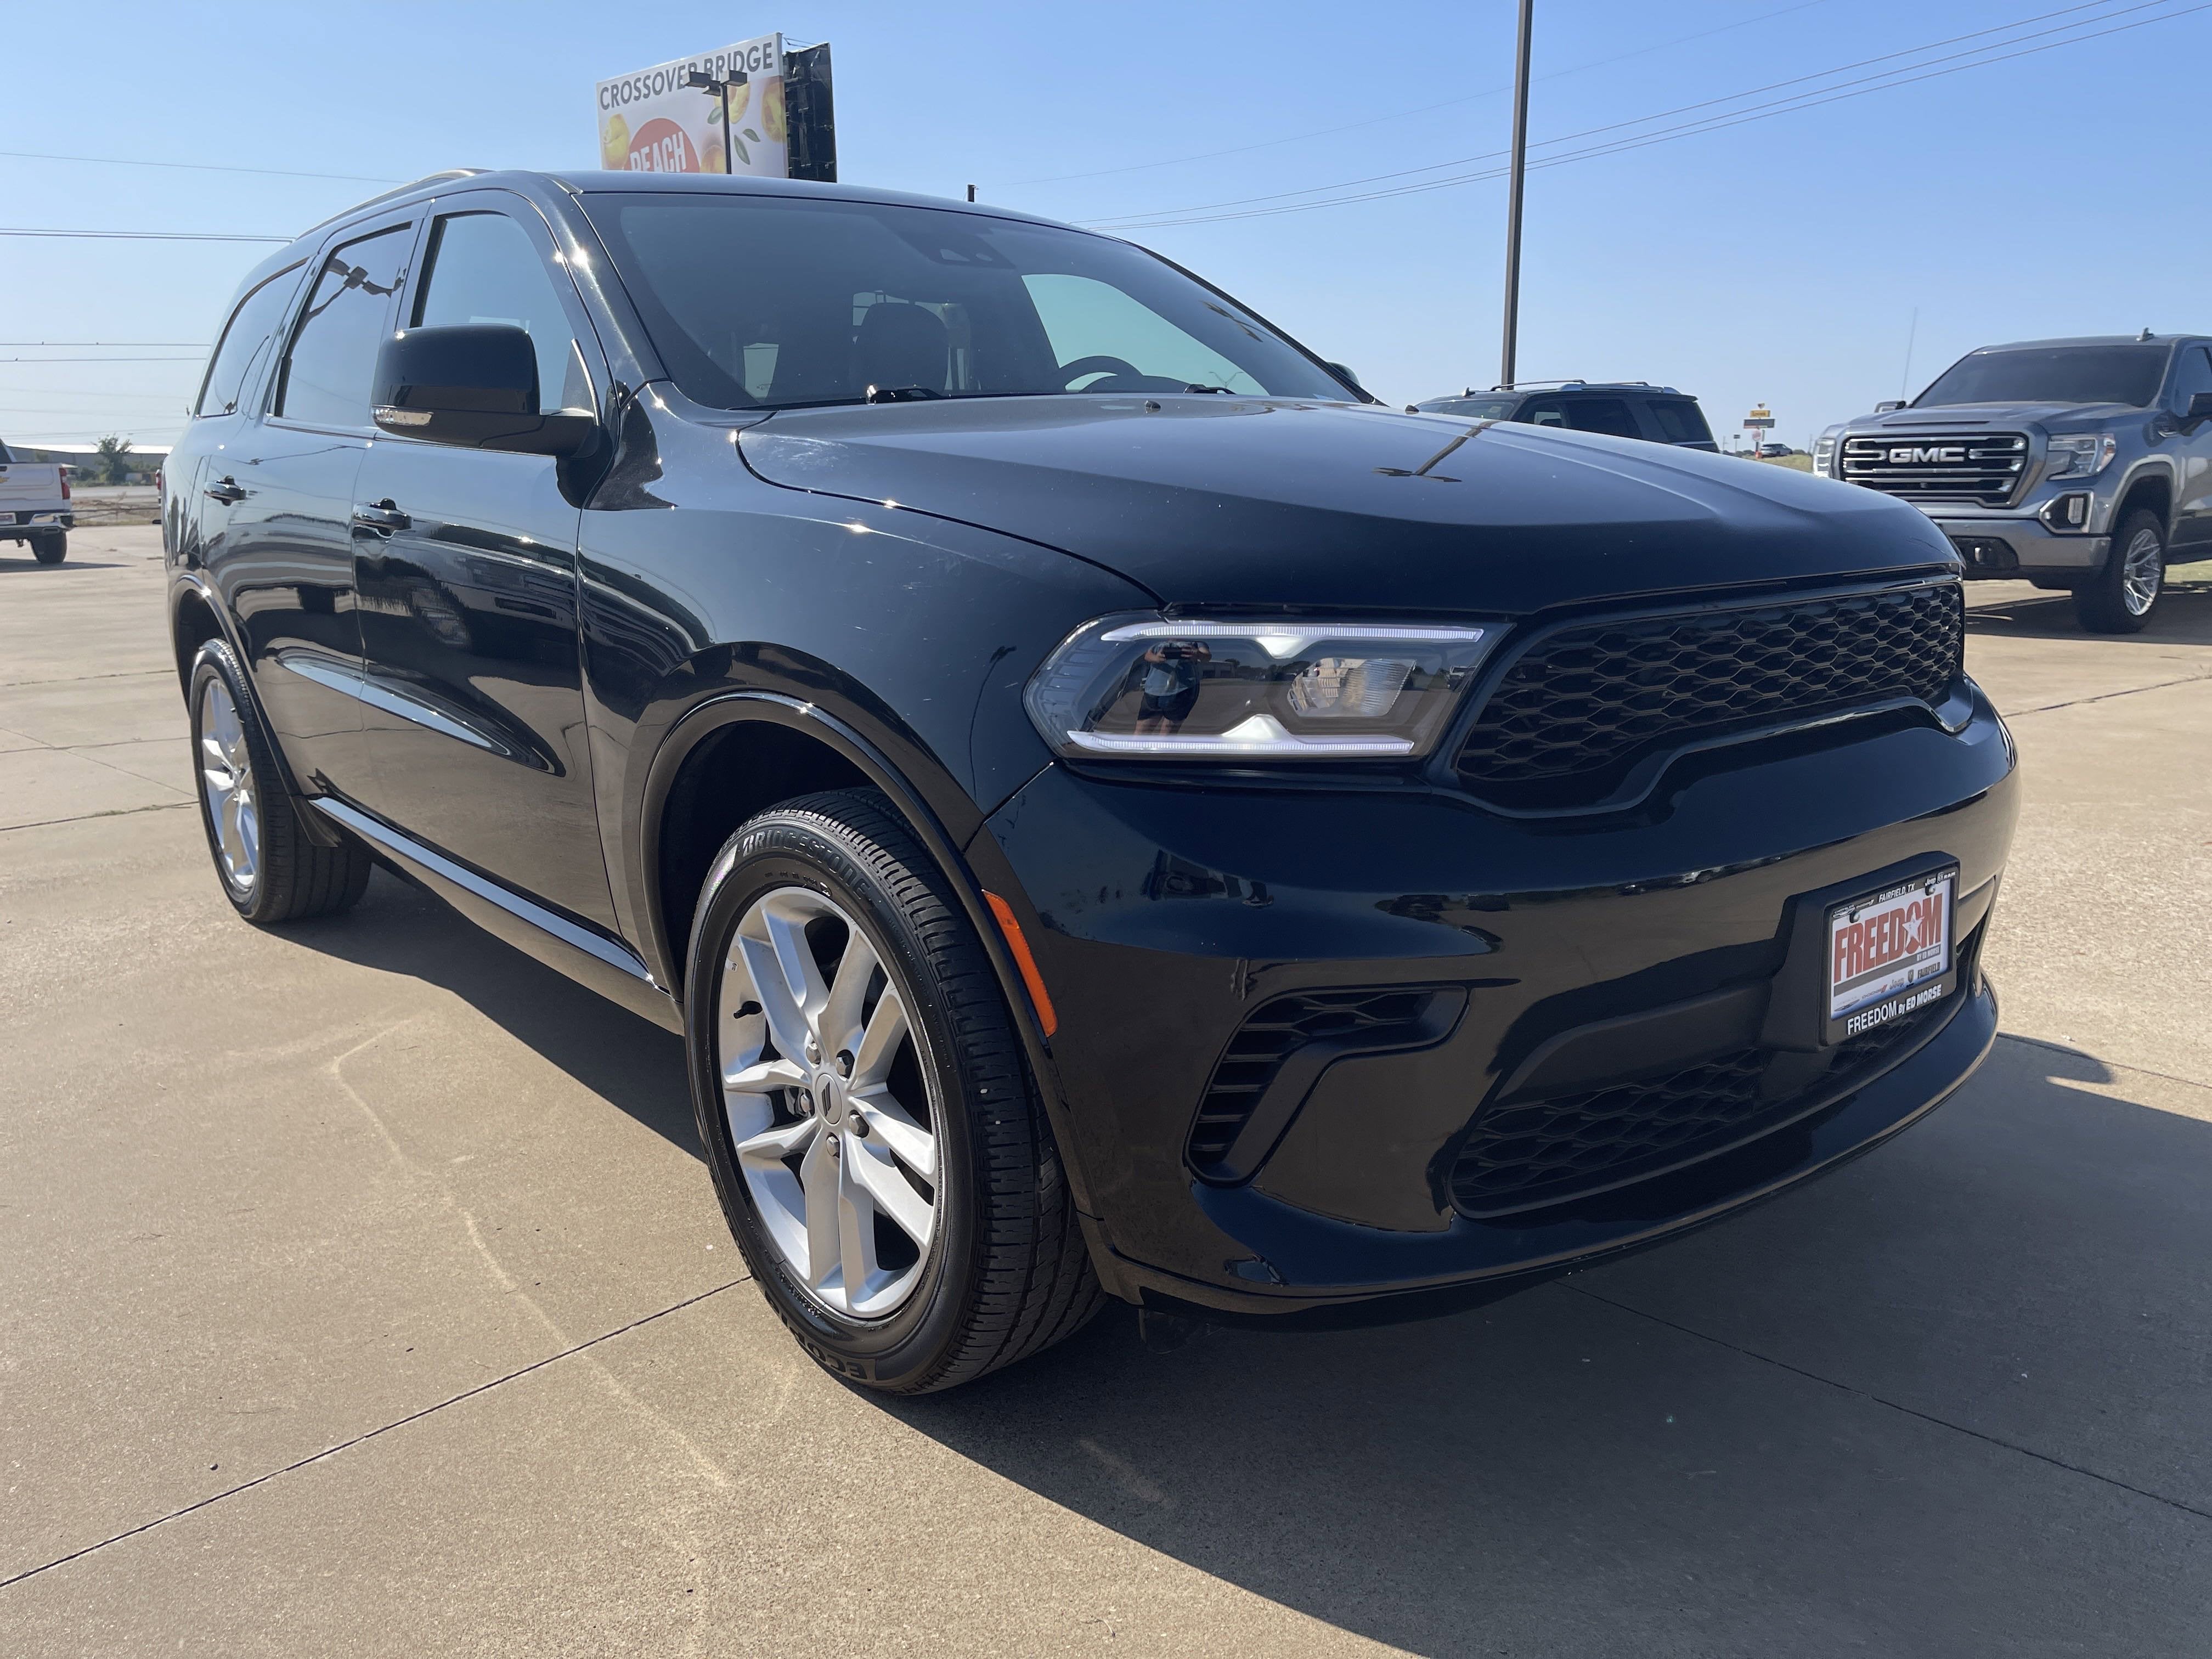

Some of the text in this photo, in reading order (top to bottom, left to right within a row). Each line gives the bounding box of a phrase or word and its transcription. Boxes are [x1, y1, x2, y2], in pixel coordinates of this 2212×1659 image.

[704, 42, 774, 81] BRIDGE
[1889, 447, 1965, 463] GMC
[1878, 883, 1915, 903] FAIRFIELD, TX
[1834, 893, 1943, 983] FREEDOM
[1847, 1000, 1897, 1035] FREEDOM
[1906, 997, 1916, 1011] ED
[1916, 984, 1942, 1007] MORSE
